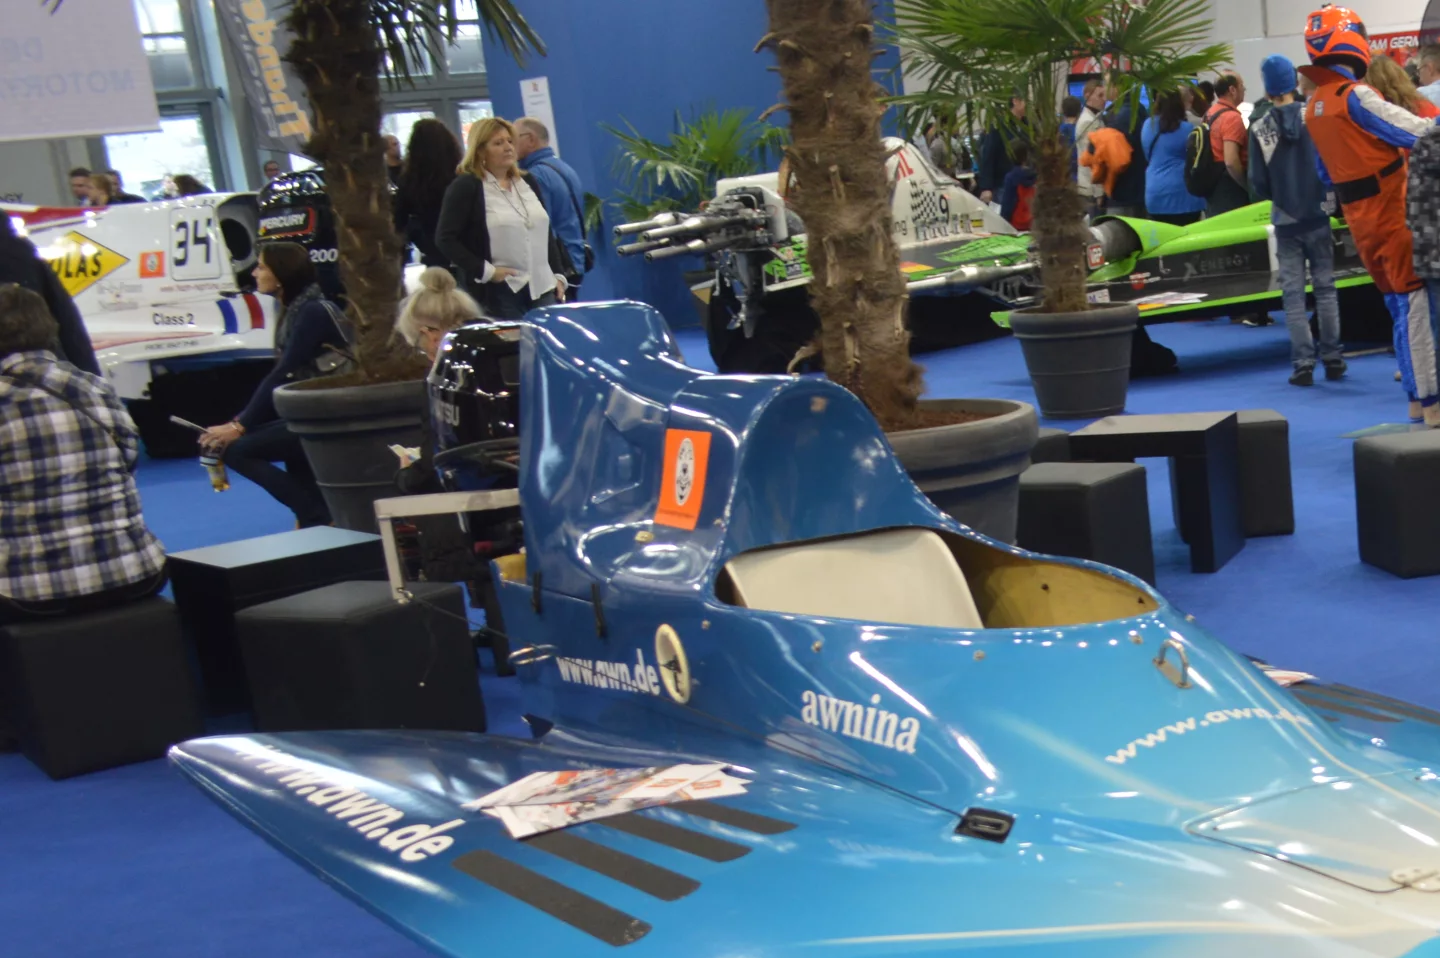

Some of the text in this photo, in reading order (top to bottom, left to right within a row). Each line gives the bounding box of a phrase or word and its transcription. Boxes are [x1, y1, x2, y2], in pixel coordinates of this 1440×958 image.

[173, 218, 213, 266] 34
[309, 248, 338, 262] 200
[152, 312, 195, 326] Class 2
[555, 648, 661, 696] www.awn.de
[801, 689, 921, 754] awnina
